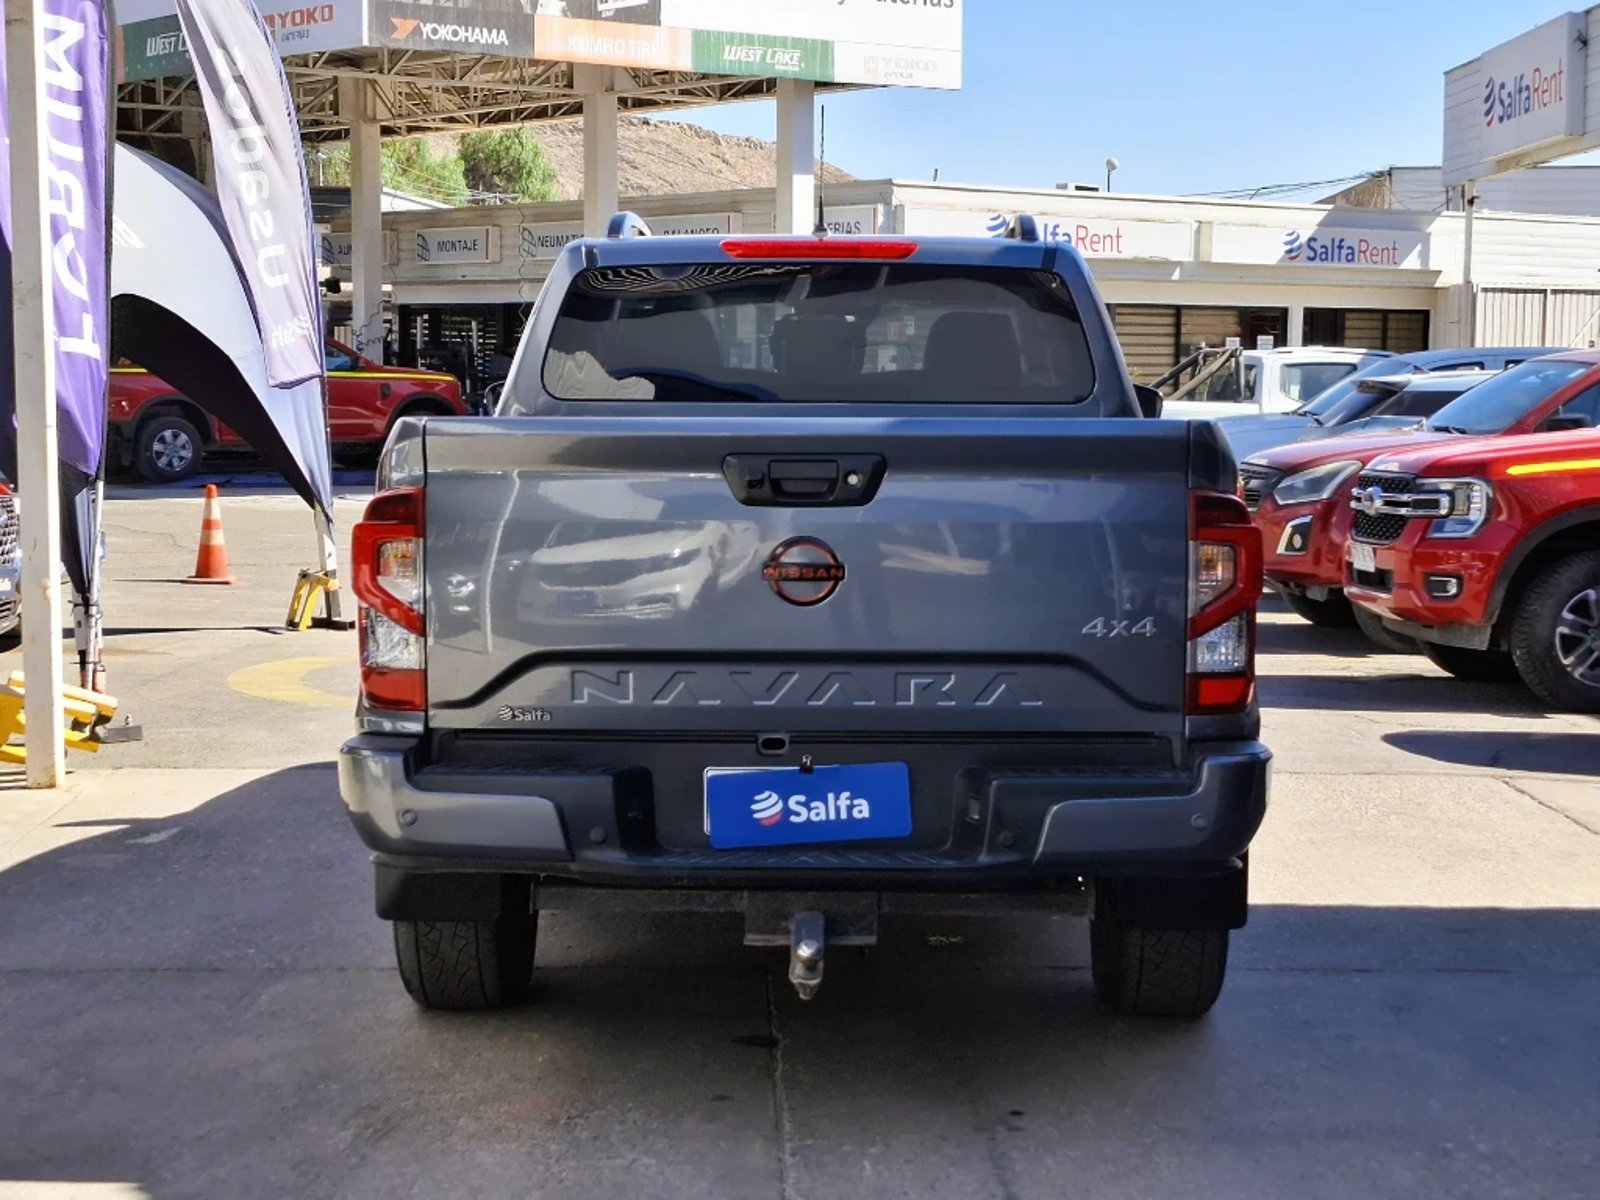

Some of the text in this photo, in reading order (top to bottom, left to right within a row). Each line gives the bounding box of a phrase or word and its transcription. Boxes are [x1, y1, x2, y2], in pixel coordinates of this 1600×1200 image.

[279, 4, 335, 29] YOKO
[146, 32, 178, 57] WEST
[419, 22, 509, 46] YOKOHAMA
[568, 34, 625, 55] KUMHO
[723, 45, 802, 65] WEST LAKE
[1497, 57, 1564, 124] SalfaRent
[437, 239, 479, 253] MONTAJE
[1306, 237, 1399, 265] SalfaRent
[763, 566, 844, 579] NISSAN
[570, 670, 1044, 705] NAVARA
[513, 708, 552, 722] Salfa
[787, 791, 871, 823] Salfa
